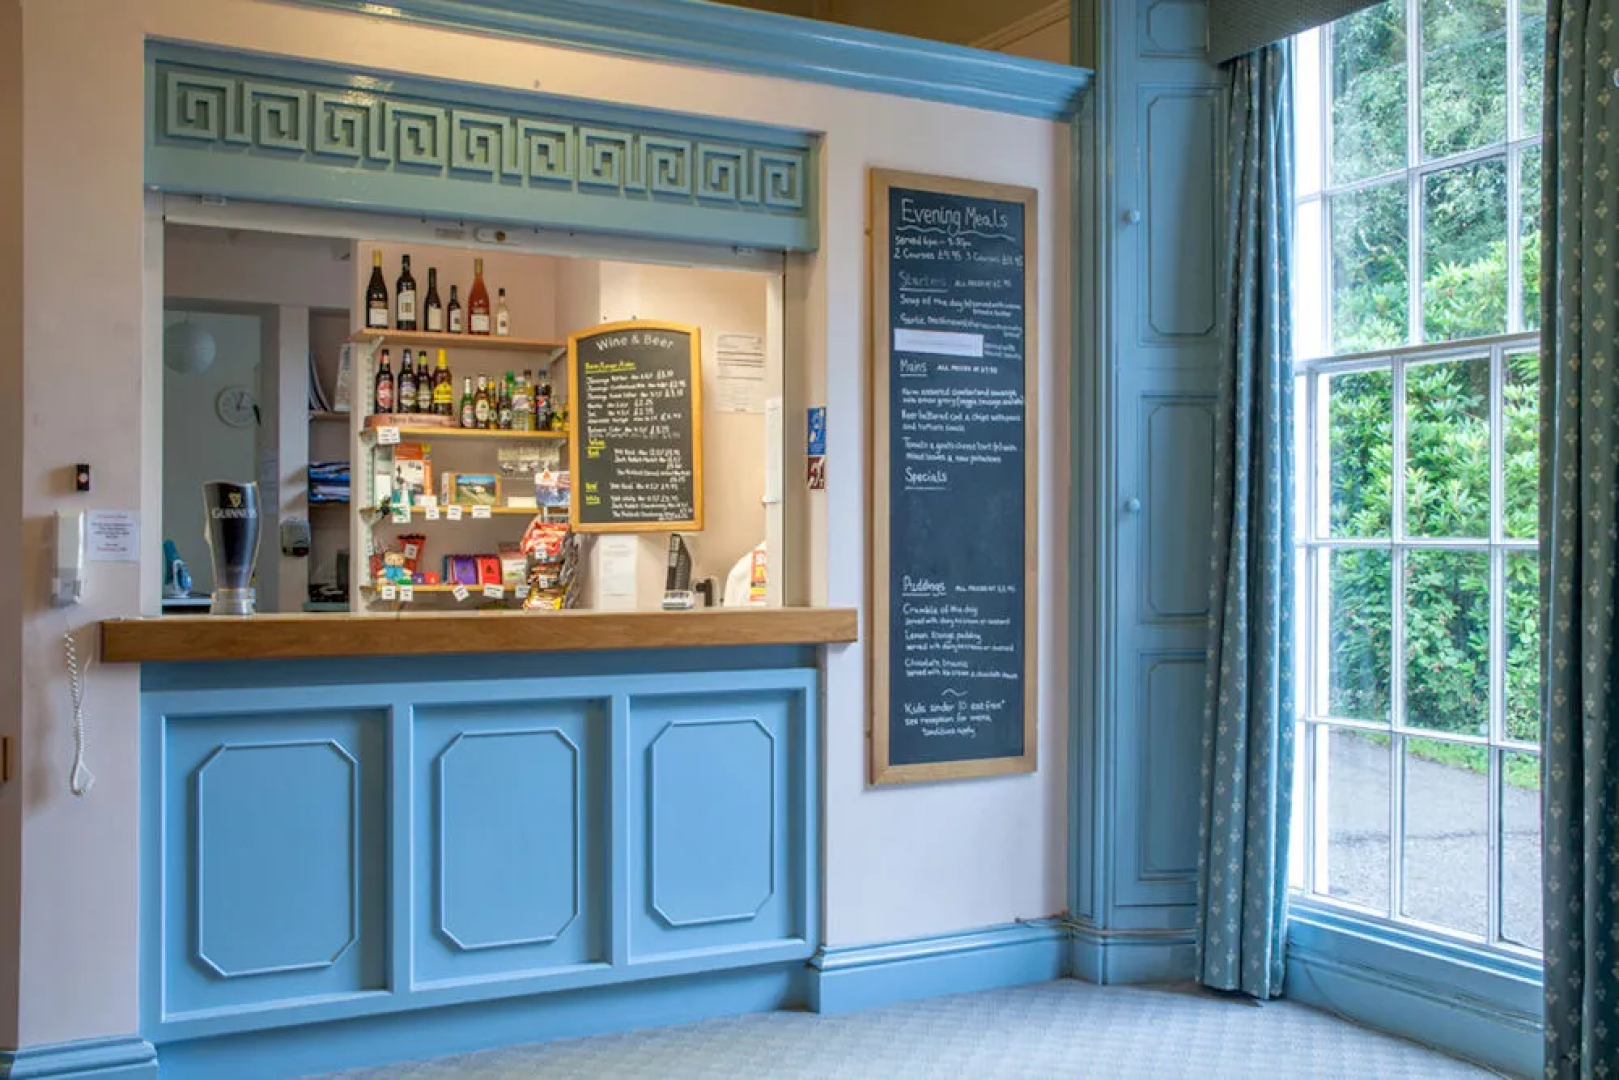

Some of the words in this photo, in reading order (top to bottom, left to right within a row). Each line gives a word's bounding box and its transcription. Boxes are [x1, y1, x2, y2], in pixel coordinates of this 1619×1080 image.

[902, 198, 960, 236] Evening
[965, 207, 1008, 229] Meals
[899, 293, 920, 307] Soup
[922, 296, 931, 306] of
[596, 337, 629, 351] Wine
[631, 333, 640, 345] &
[643, 334, 674, 350] Beer
[899, 358, 927, 374] Mains
[904, 465, 948, 485] Specials
[901, 574, 947, 593] Puddings
[902, 602, 939, 616] Crumble
[940, 603, 949, 615] of
[903, 701, 927, 715] Kids
[930, 700, 955, 713] under
